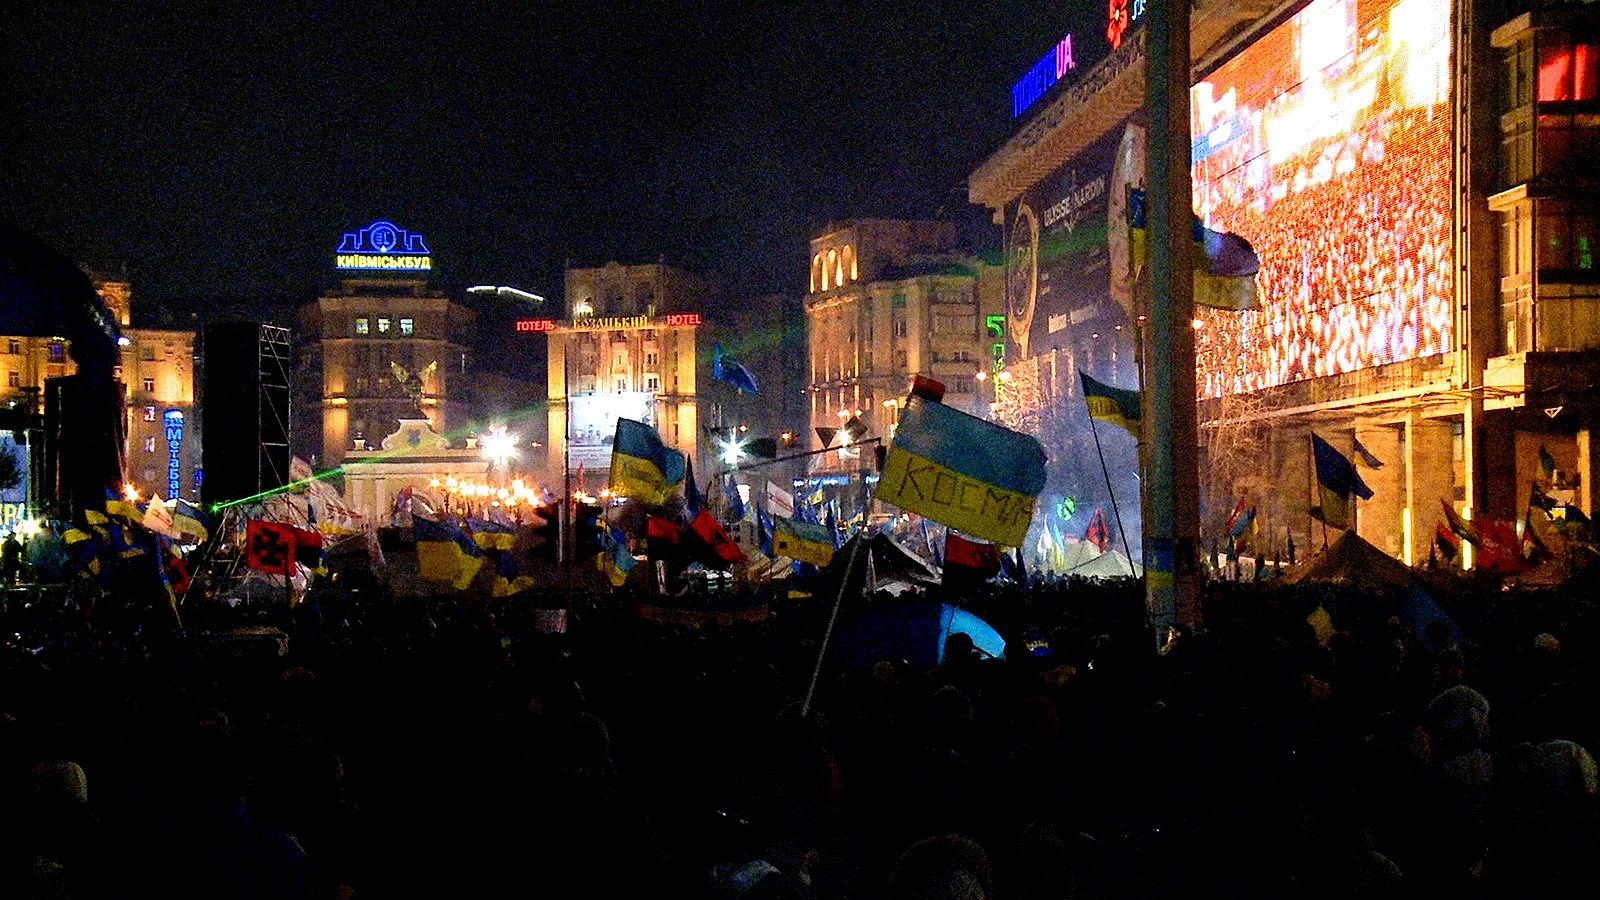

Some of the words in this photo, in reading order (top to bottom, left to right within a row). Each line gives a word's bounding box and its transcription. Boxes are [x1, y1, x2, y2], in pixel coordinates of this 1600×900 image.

[337, 254, 431, 269] КИЇВМІСЬКБУД
[516, 320, 555, 332] ГОТЕЛЬ
[666, 313, 702, 326] HOTEL
